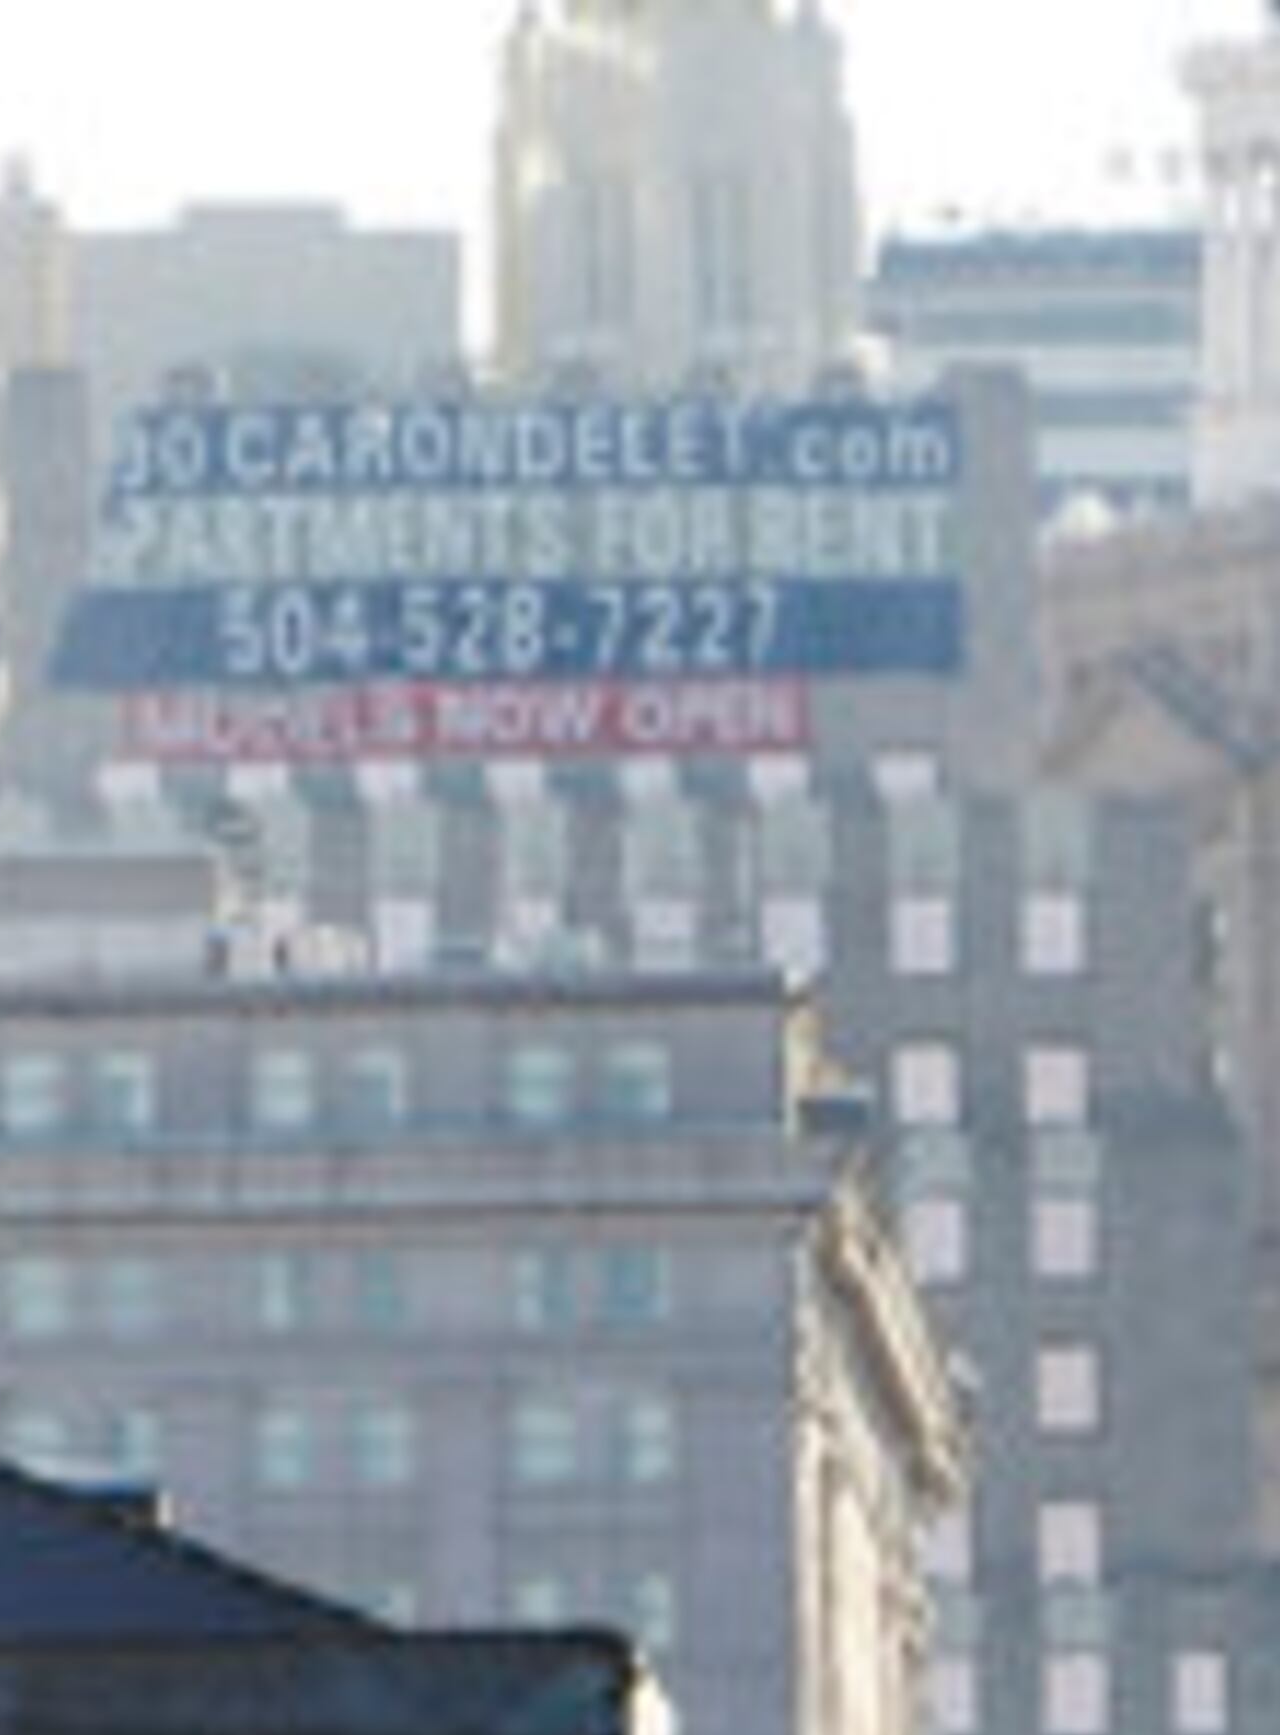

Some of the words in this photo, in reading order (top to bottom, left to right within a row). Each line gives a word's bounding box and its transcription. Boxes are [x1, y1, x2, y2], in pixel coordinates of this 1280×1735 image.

[596, 496, 734, 572] FOR
[746, 492, 952, 572] RENT
[432, 684, 604, 744] NOW
[620, 684, 798, 744] OPEN
